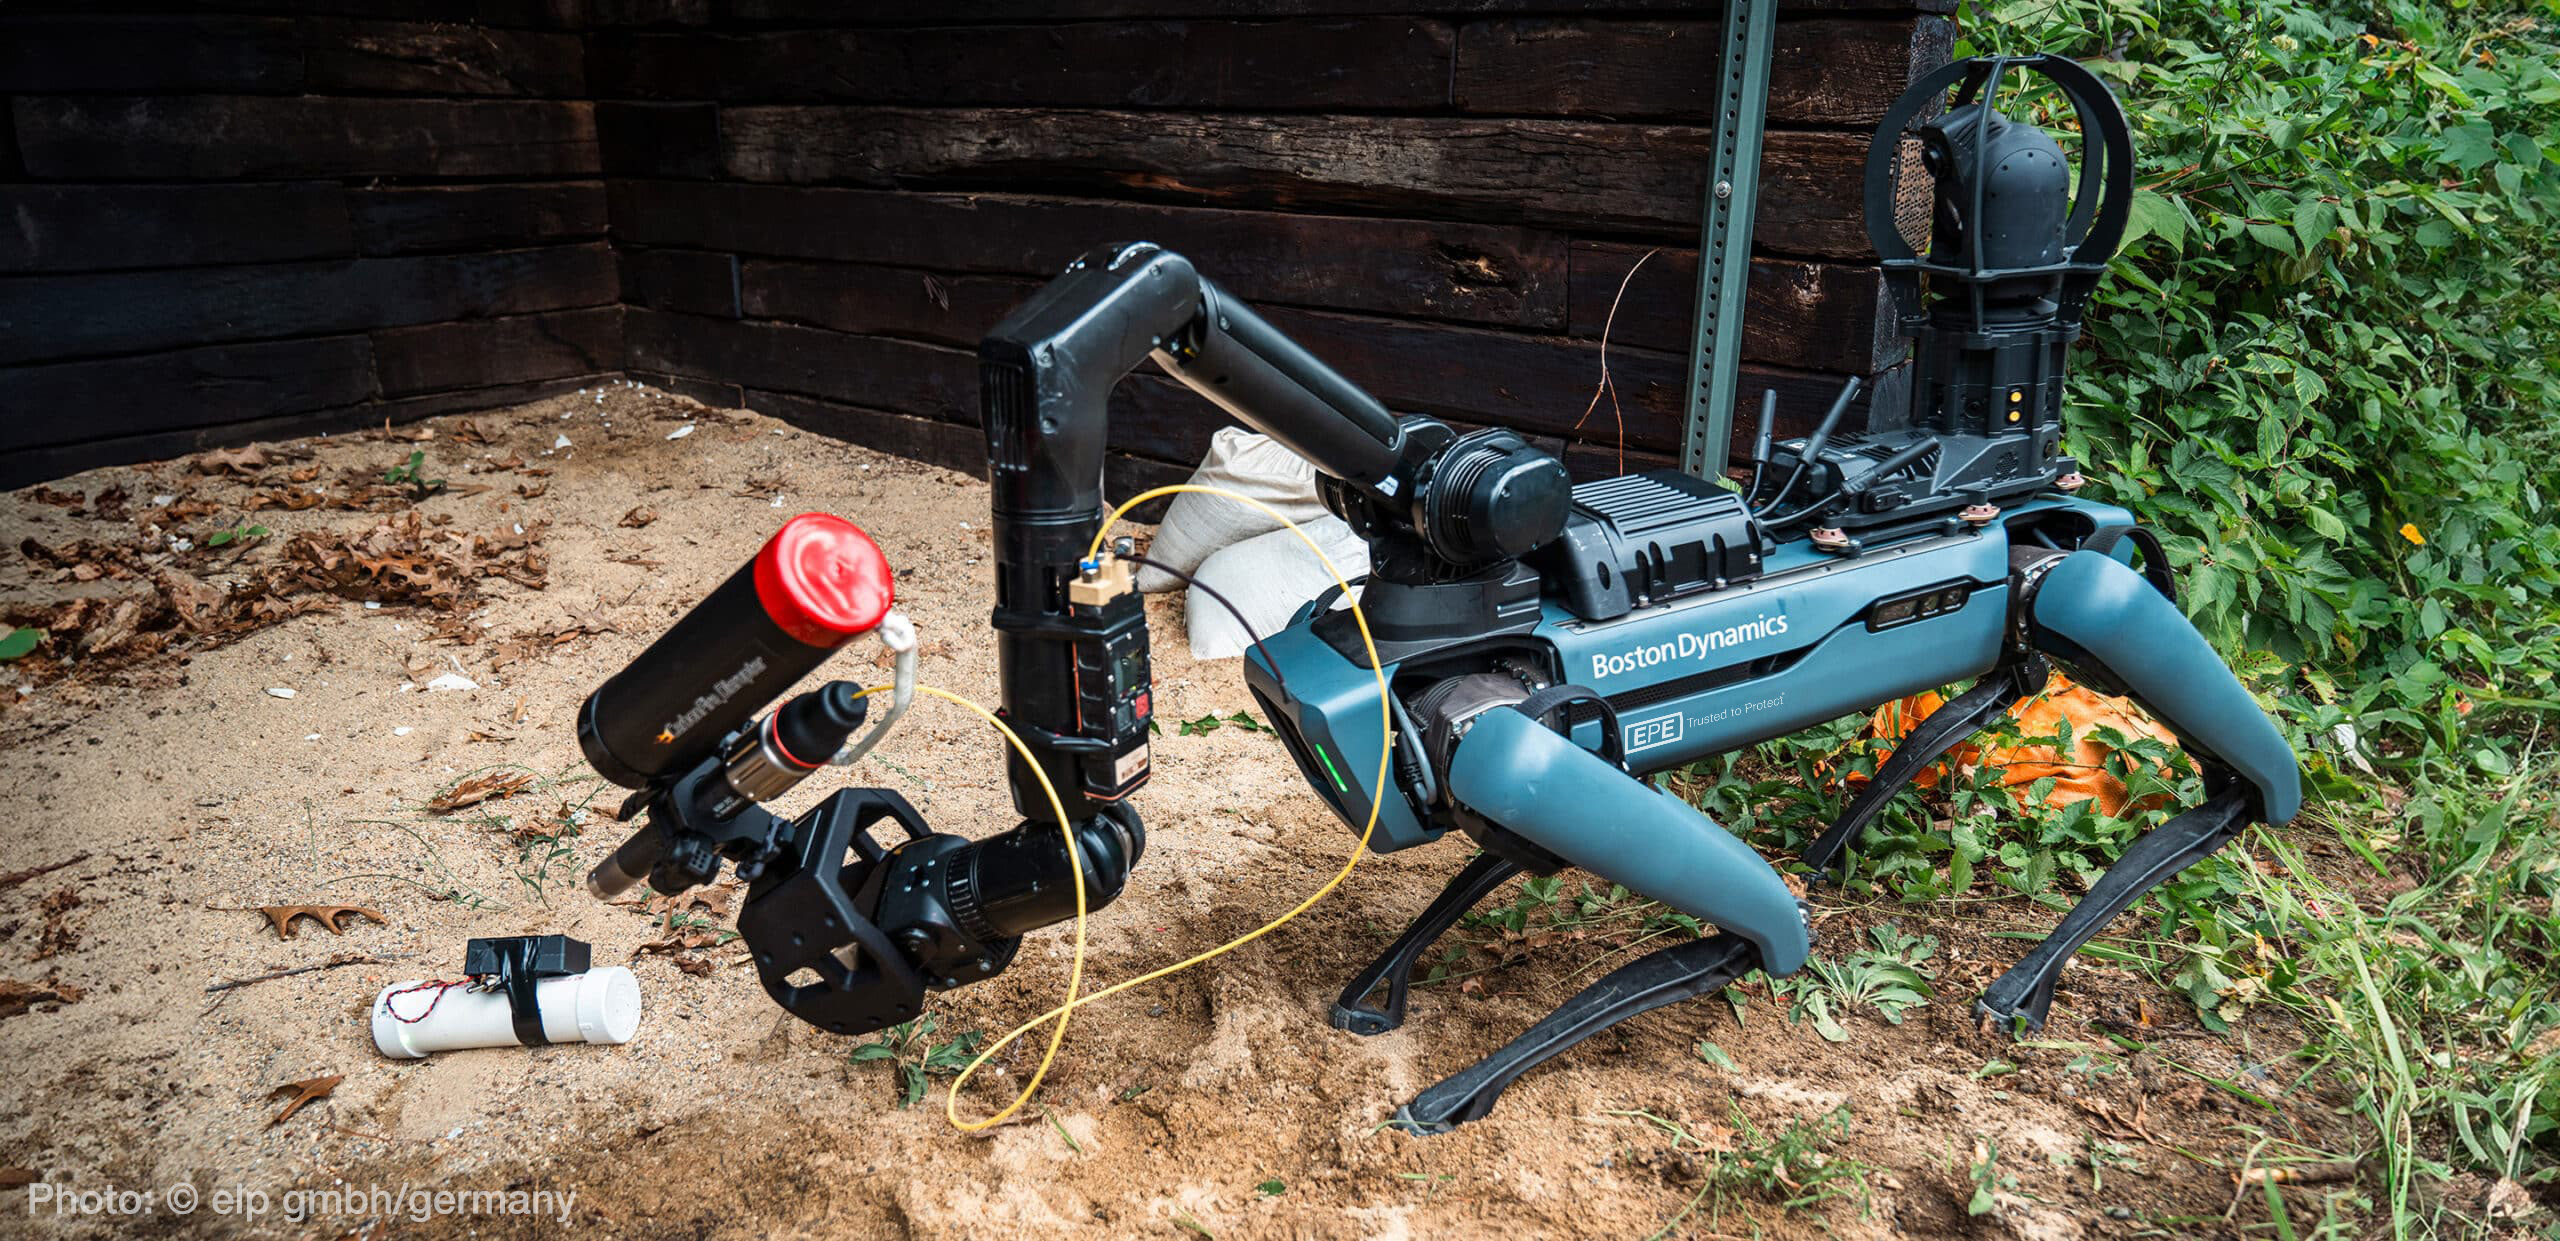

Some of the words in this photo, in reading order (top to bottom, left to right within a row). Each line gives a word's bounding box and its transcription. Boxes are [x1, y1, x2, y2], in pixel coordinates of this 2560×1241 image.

[1592, 642, 1676, 679] Boston
[1678, 613, 1788, 660] Dynamics
[1686, 708, 1727, 728] Trusted
[1731, 707, 1742, 717] to
[1634, 719, 1675, 747] EPE
